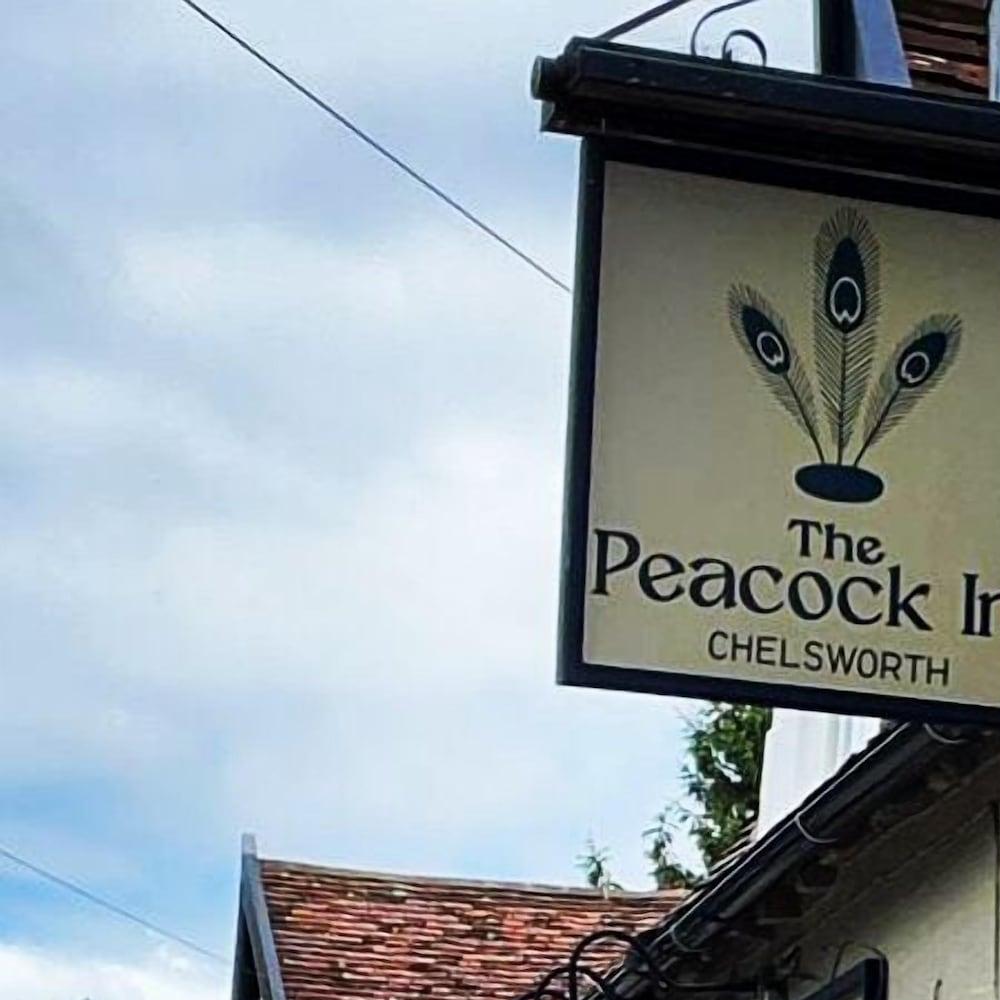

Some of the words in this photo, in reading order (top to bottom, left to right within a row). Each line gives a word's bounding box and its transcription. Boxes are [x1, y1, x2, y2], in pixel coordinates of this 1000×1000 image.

[787, 519, 885, 565] The
[590, 528, 933, 632] Peacock
[707, 630, 949, 687] CHELSWORTH
